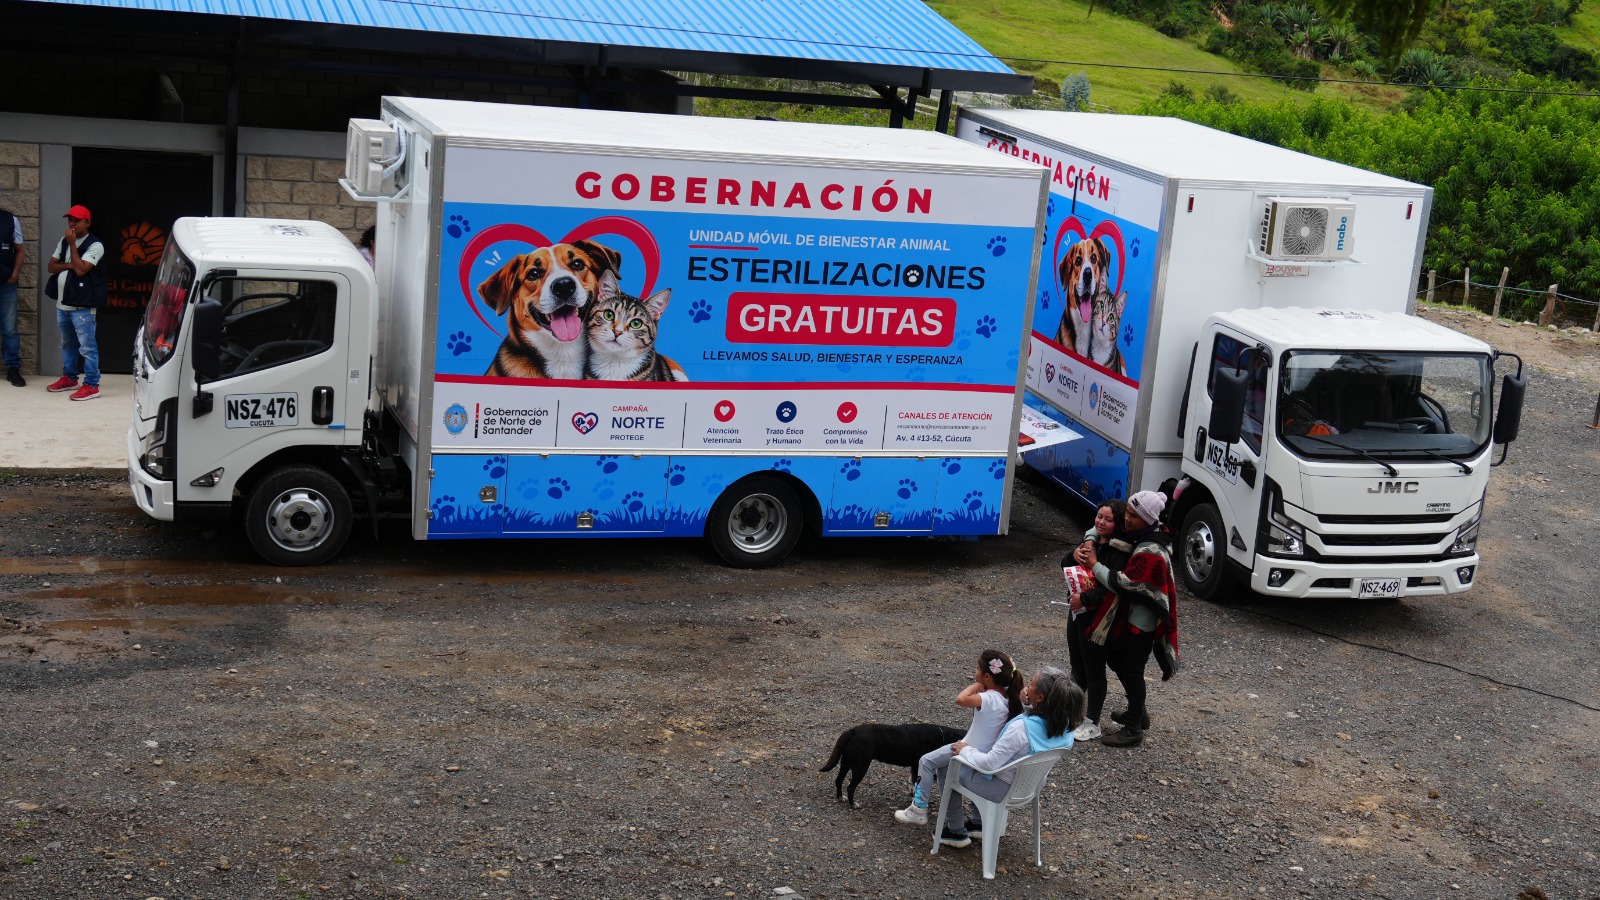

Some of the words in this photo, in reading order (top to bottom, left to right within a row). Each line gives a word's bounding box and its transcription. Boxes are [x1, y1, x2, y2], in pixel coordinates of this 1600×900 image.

[575, 171, 932, 214] GOBERNACIÓN
[689, 229, 745, 243] UNIDAD
[748, 229, 792, 245] MÓVIL
[796, 233, 815, 246] DE
[818, 235, 896, 249] BIENESTAR
[899, 238, 951, 251] ANIMAL
[1336, 216, 1348, 251] mabe
[687, 256, 986, 290] ESTERILIZACIONES
[739, 303, 943, 336] GRATUITAS
[702, 350, 768, 361] LLEVAMOS
[771, 351, 814, 363] SALUD,
[817, 352, 882, 363] BIENESTAR
[886, 354, 893, 363] Y
[895, 354, 963, 365] ESPERANZA
[1058, 373, 1079, 393] NORTE
[227, 399, 261, 420] NSZ
[266, 397, 296, 418] 476
[483, 407, 549, 416] Gobernación
[612, 404, 648, 412] CAMPAÑA
[483, 417, 496, 425] de
[499, 417, 526, 425] Norte
[529, 417, 542, 425] de
[938, 412, 950, 420] DE
[951, 411, 993, 420] ATENCIÓN
[611, 416, 665, 429] NORTE
[482, 426, 533, 435] Santander
[785, 427, 804, 435] Ético
[823, 428, 868, 436] Compromiso
[895, 434, 908, 442] Av.
[909, 434, 915, 442] 4
[945, 434, 972, 442] Cúcuta
[1207, 441, 1224, 468] NSZ
[1367, 481, 1420, 494] JMC
[1360, 582, 1379, 593] NSZ
[1381, 581, 1399, 593] 469
